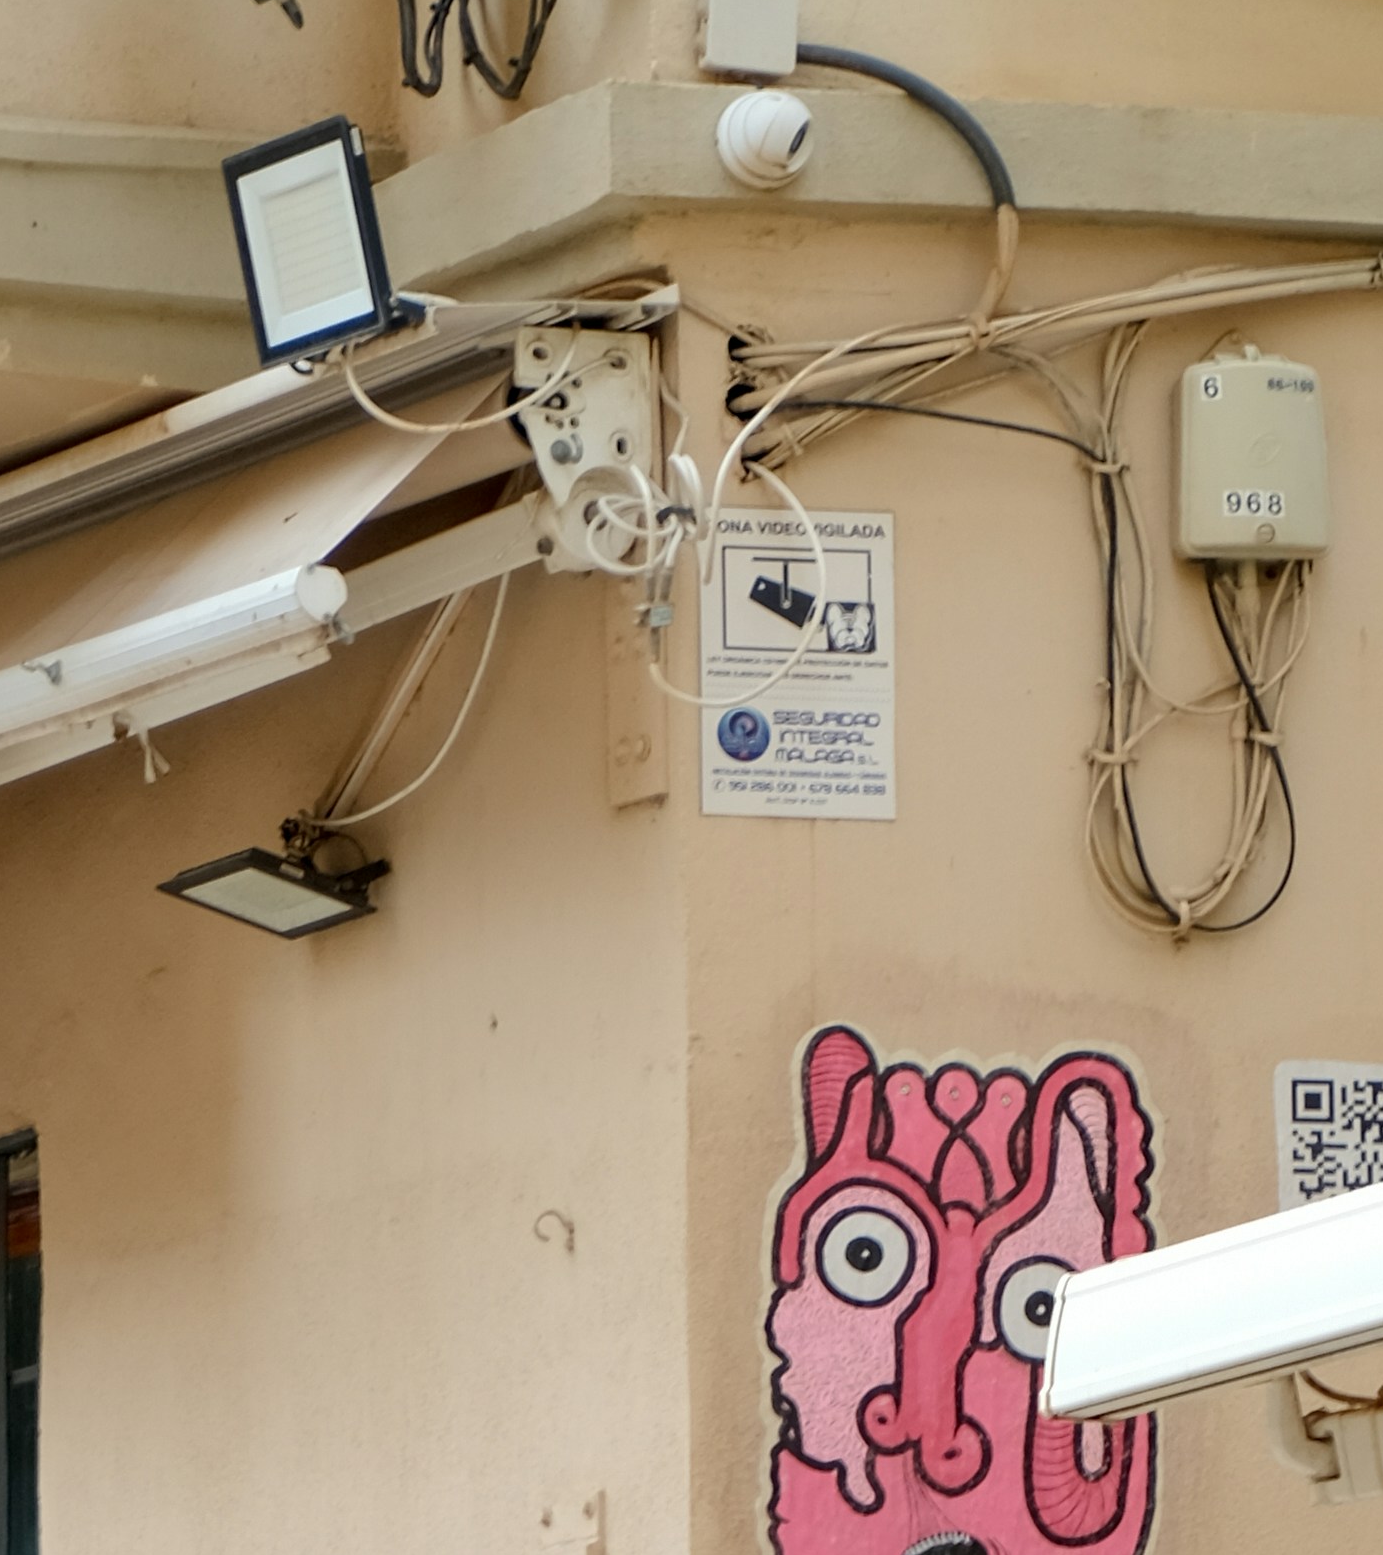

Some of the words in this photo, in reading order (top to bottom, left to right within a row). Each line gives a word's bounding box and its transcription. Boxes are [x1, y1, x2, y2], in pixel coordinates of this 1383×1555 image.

[1203, 377, 1219, 399] 6
[1225, 491, 1283, 517] 968
[710, 519, 753, 535] ONA
[773, 710, 881, 727] SEGURIDAD
[779, 728, 875, 746] INTEGRAL
